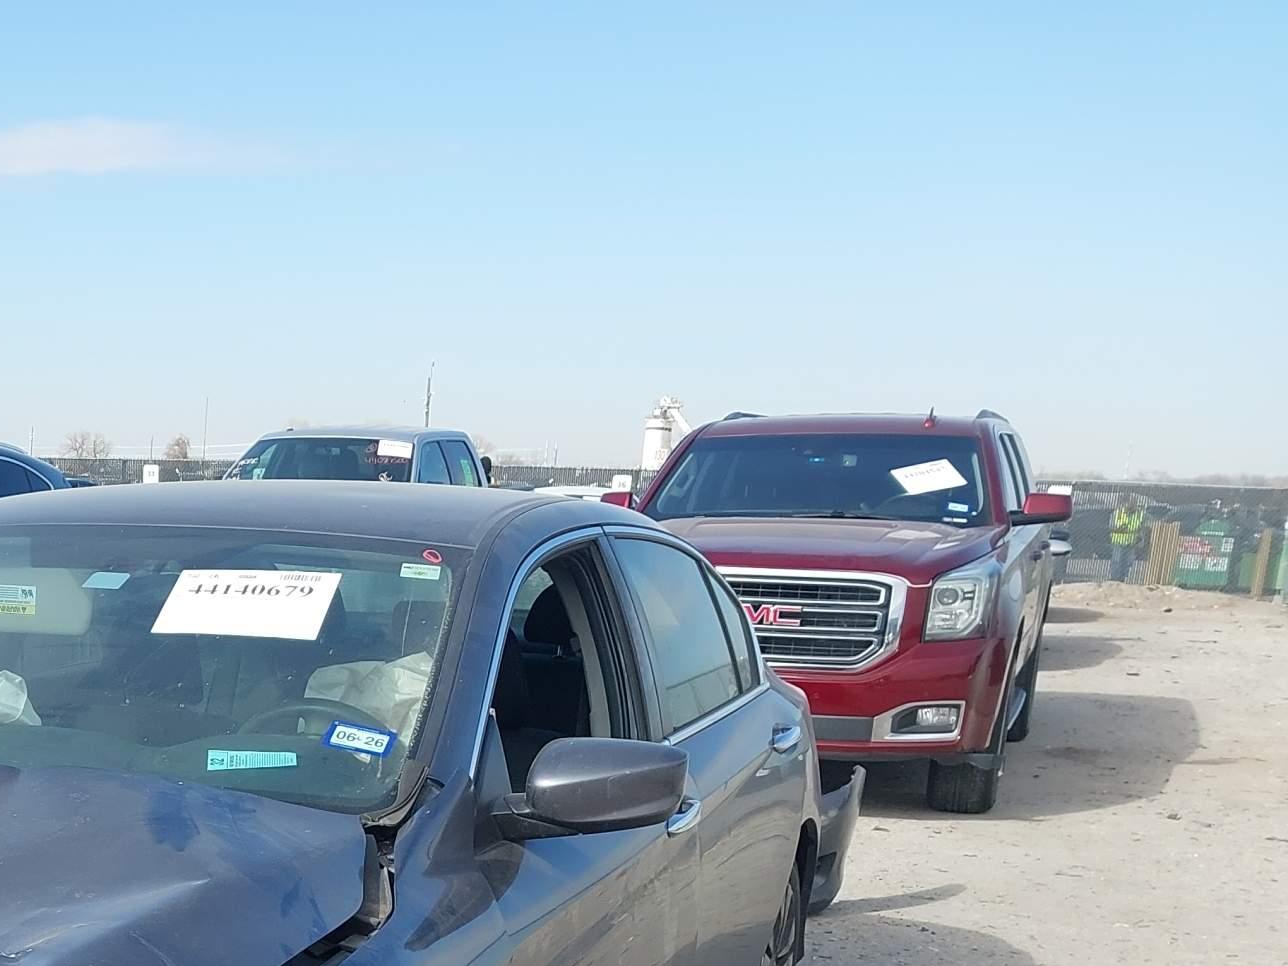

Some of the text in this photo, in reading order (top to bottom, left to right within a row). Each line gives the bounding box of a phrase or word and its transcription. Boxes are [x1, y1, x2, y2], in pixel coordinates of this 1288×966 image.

[188, 584, 314, 598] 44140679
[741, 602, 802, 627] MC
[336, 730, 385, 748] 06 26
